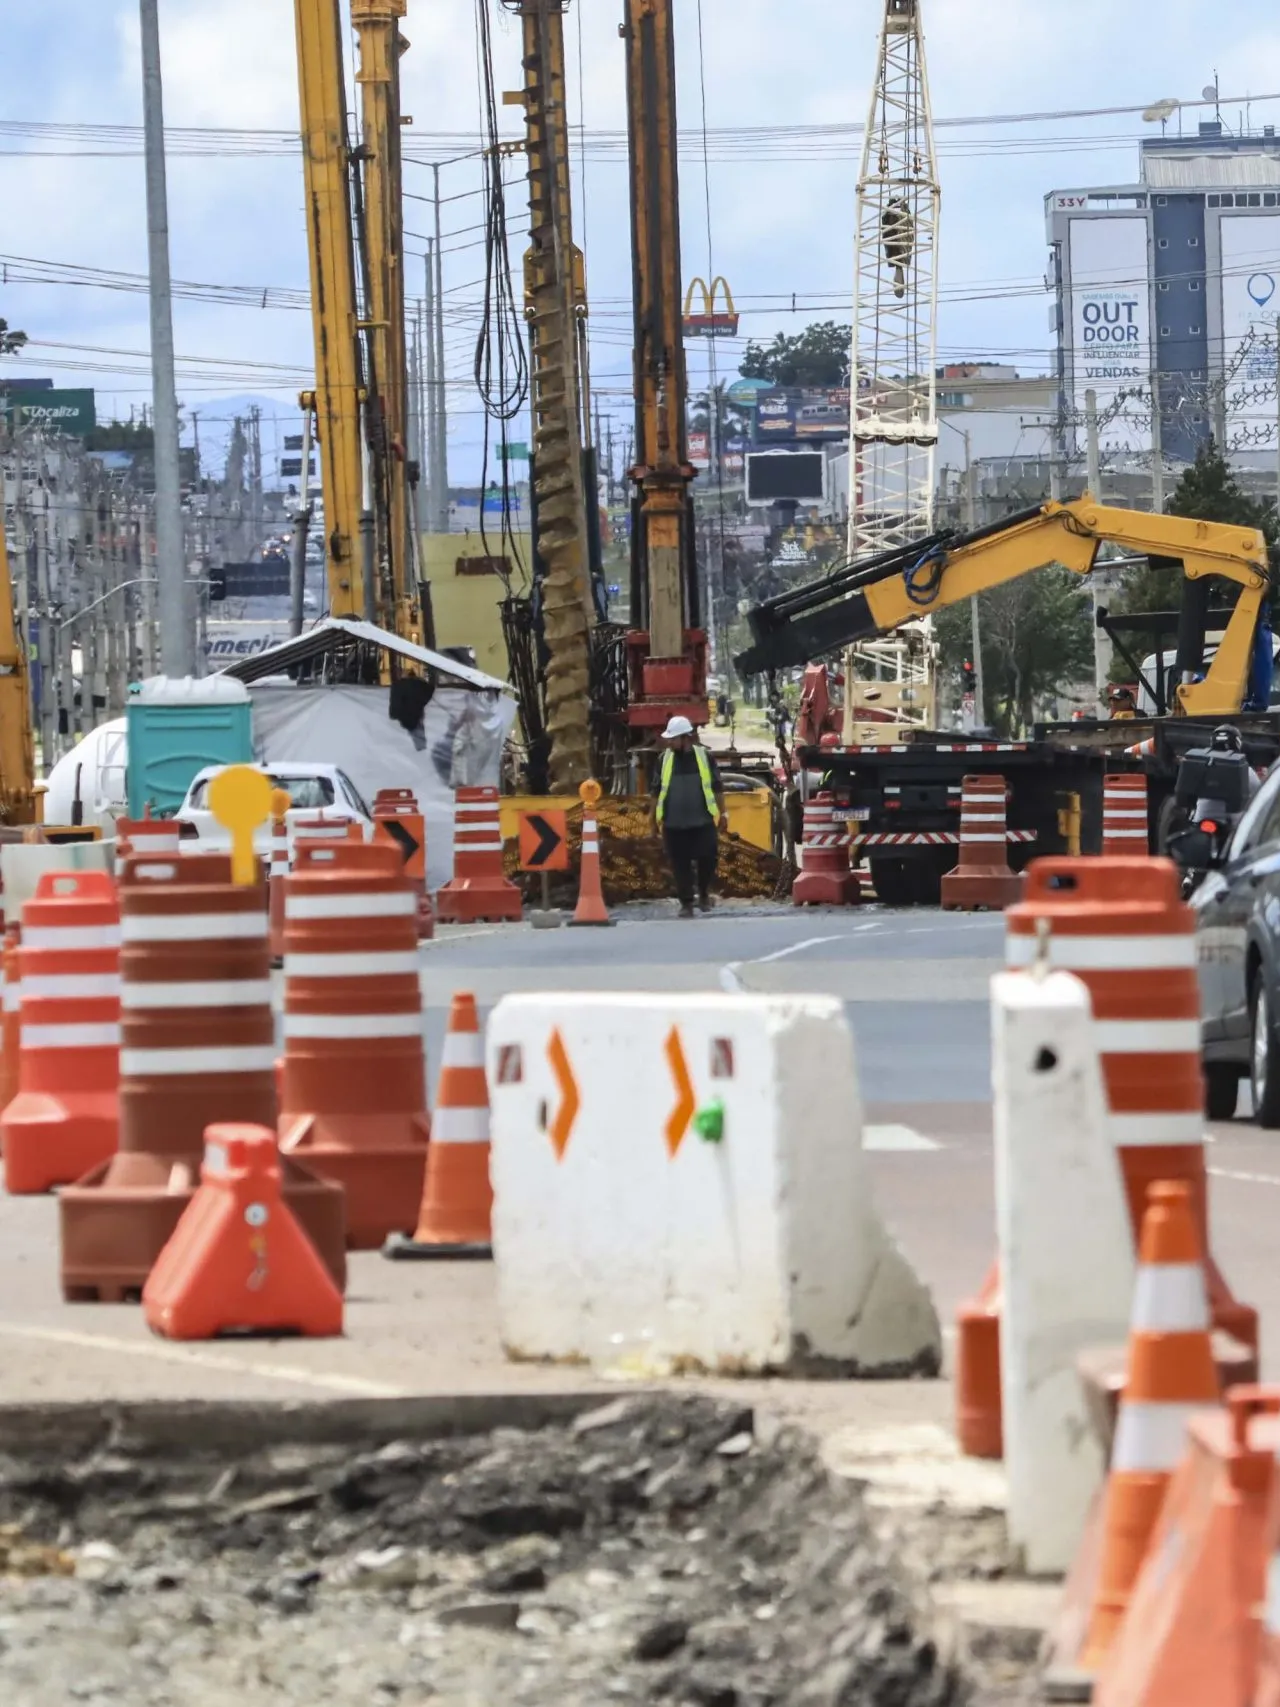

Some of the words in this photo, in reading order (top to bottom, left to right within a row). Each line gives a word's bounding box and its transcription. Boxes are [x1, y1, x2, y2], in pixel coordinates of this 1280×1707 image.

[1082, 301, 1138, 324] OUT
[1083, 325, 1139, 342] DOOR
[1084, 351, 1140, 359] INFLUENCIAR
[1086, 366, 1141, 378] VENDAS
